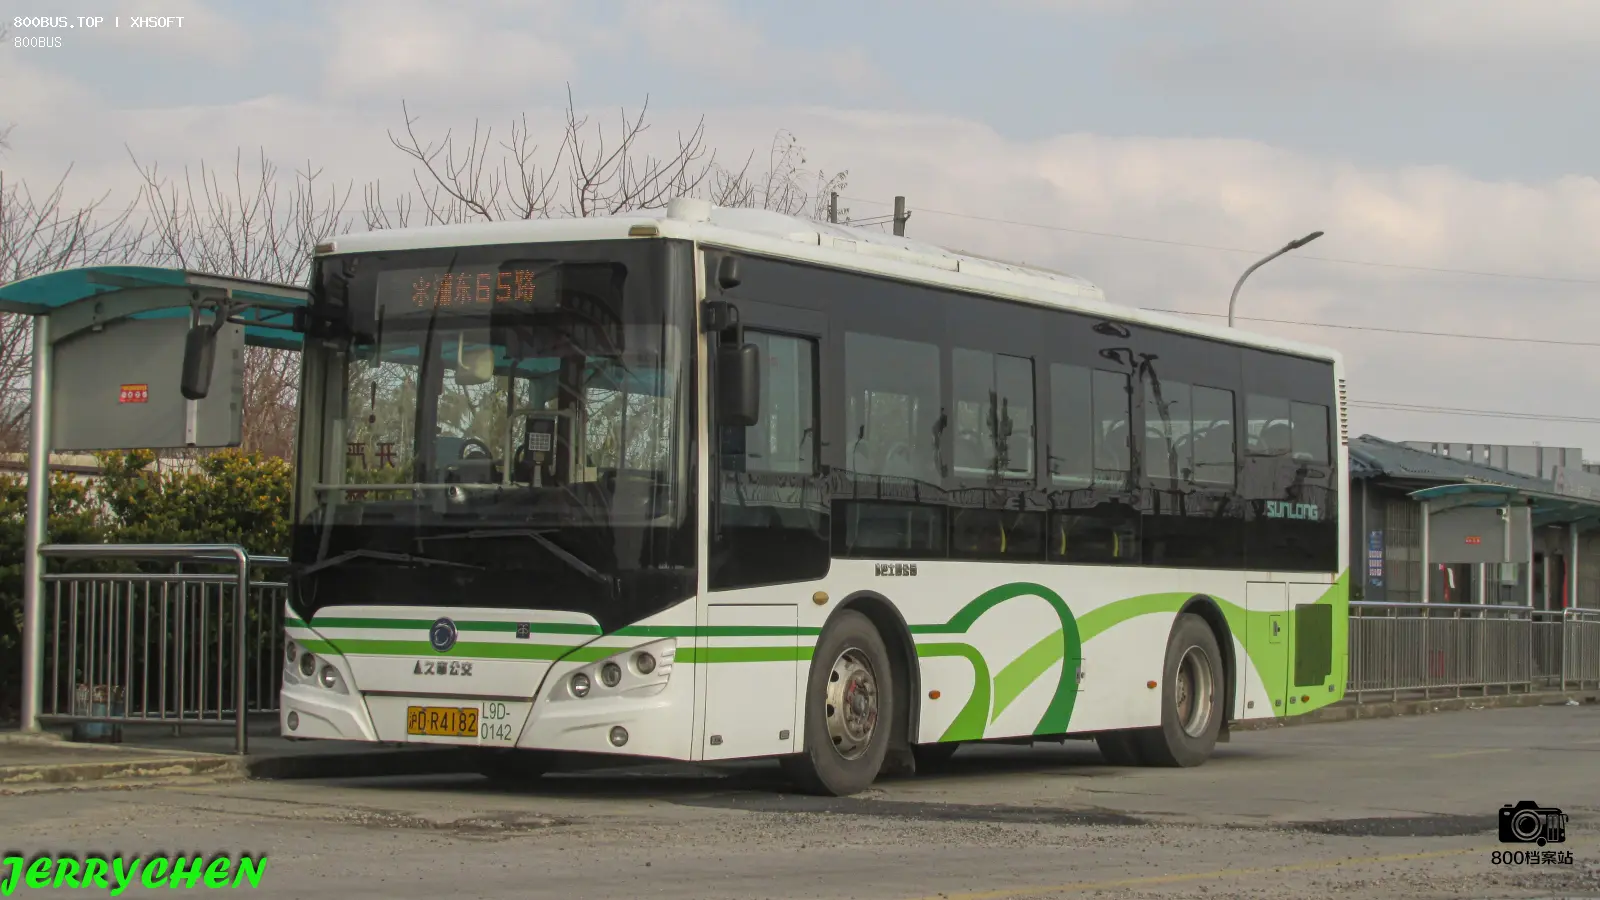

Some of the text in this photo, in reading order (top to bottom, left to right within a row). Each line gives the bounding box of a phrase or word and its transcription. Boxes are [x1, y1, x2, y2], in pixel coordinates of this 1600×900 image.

[1266, 500, 1319, 520] SUNLONG
[482, 702, 510, 720] L9D-
[481, 722, 512, 741] 0142
